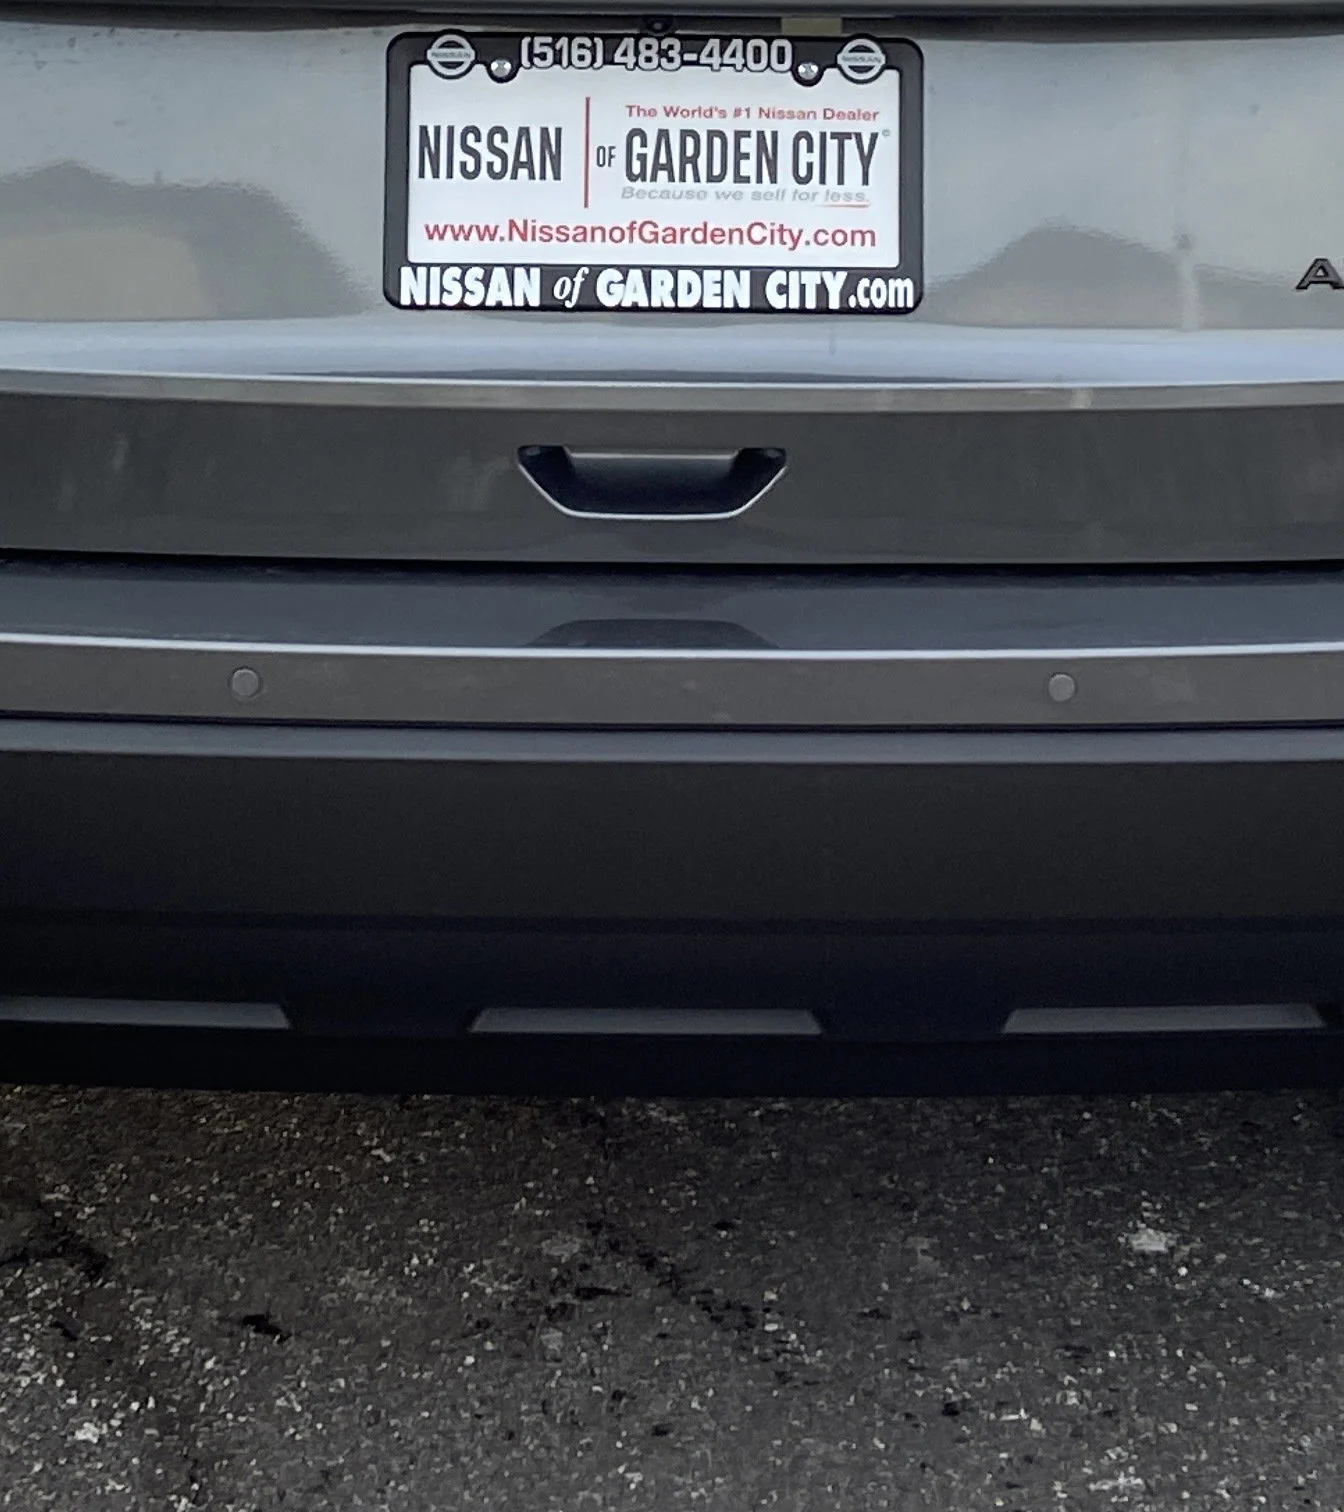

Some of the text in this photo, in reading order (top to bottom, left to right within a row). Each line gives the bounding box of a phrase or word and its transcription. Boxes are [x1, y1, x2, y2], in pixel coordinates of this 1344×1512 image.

[520, 36, 793, 72] (516) 483-4400
[625, 105, 879, 121] The World's #1 Nissan Dealer
[418, 125, 879, 186] NISSAN OF GARDEN CITY
[621, 187, 870, 203] Because we sell for less.
[424, 219, 876, 251] www.NissanofGardenCity.com
[400, 266, 915, 310] NISSAN of GARDEN CITY.com
